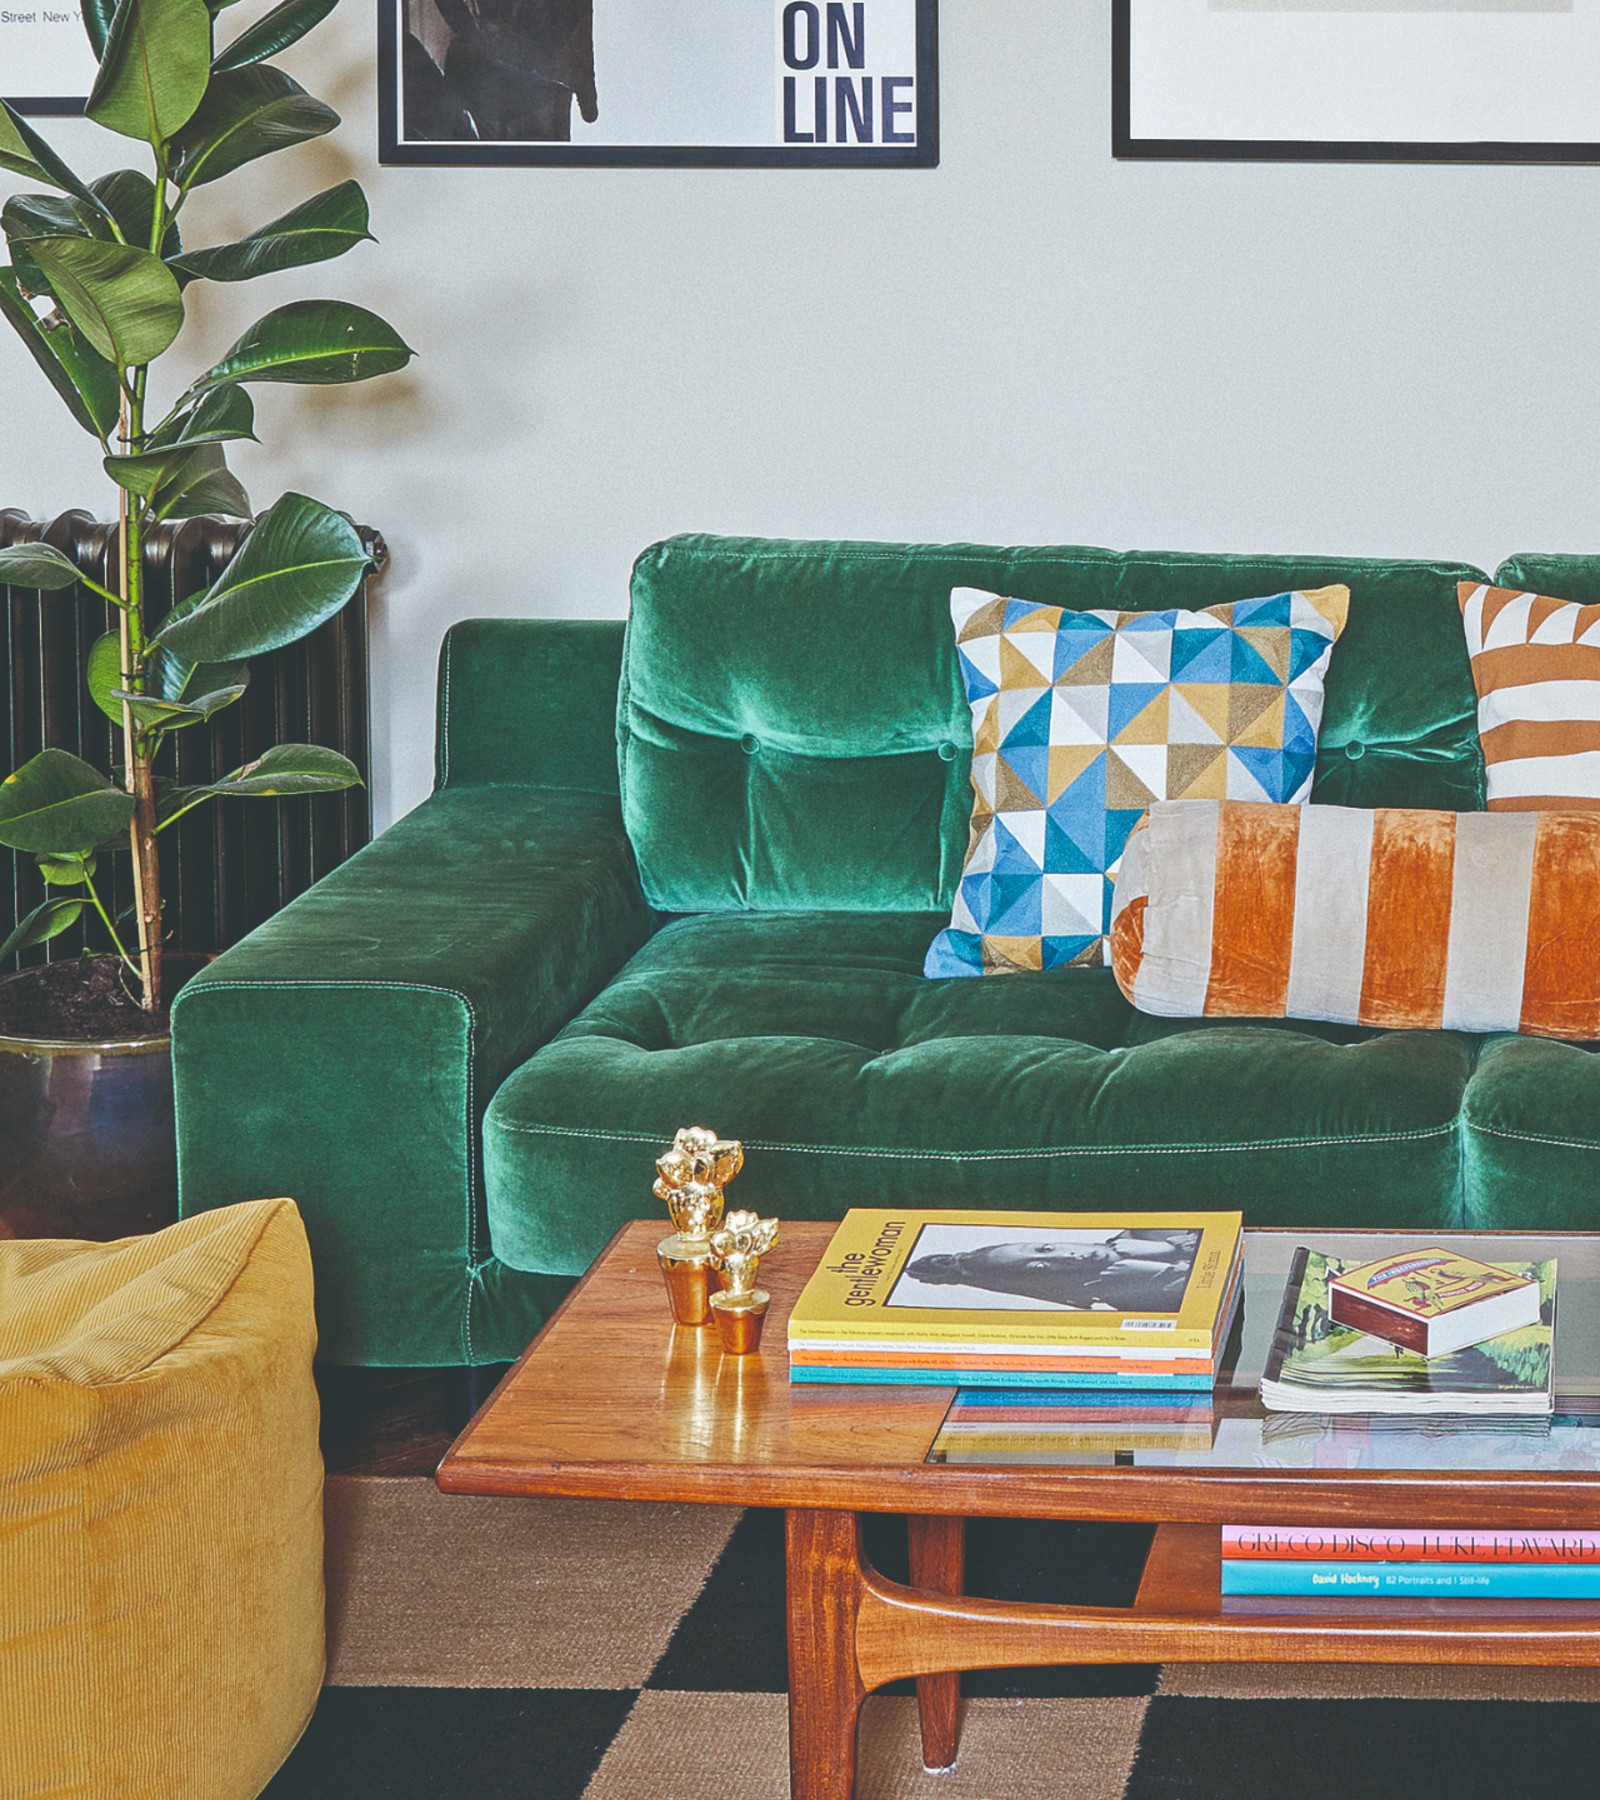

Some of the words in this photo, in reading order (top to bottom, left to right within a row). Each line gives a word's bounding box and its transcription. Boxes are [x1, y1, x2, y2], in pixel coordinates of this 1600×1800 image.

[1, 11, 36, 23] Street
[43, 11, 70, 23] New
[783, 1, 865, 70] ON
[783, 76, 915, 143] LINE
[826, 1253, 865, 1273] the
[844, 1222, 906, 1306] gentlewoman
[1238, 1532, 1324, 1553] GRECO
[1332, 1534, 1406, 1555] DISCO
[1422, 1536, 1486, 1556] LUKE
[1493, 1537, 1596, 1557] EDWARD
[1312, 1573, 1337, 1584] David
[1398, 1575, 1434, 1585] Portraits
[1436, 1576, 1452, 1585] and
